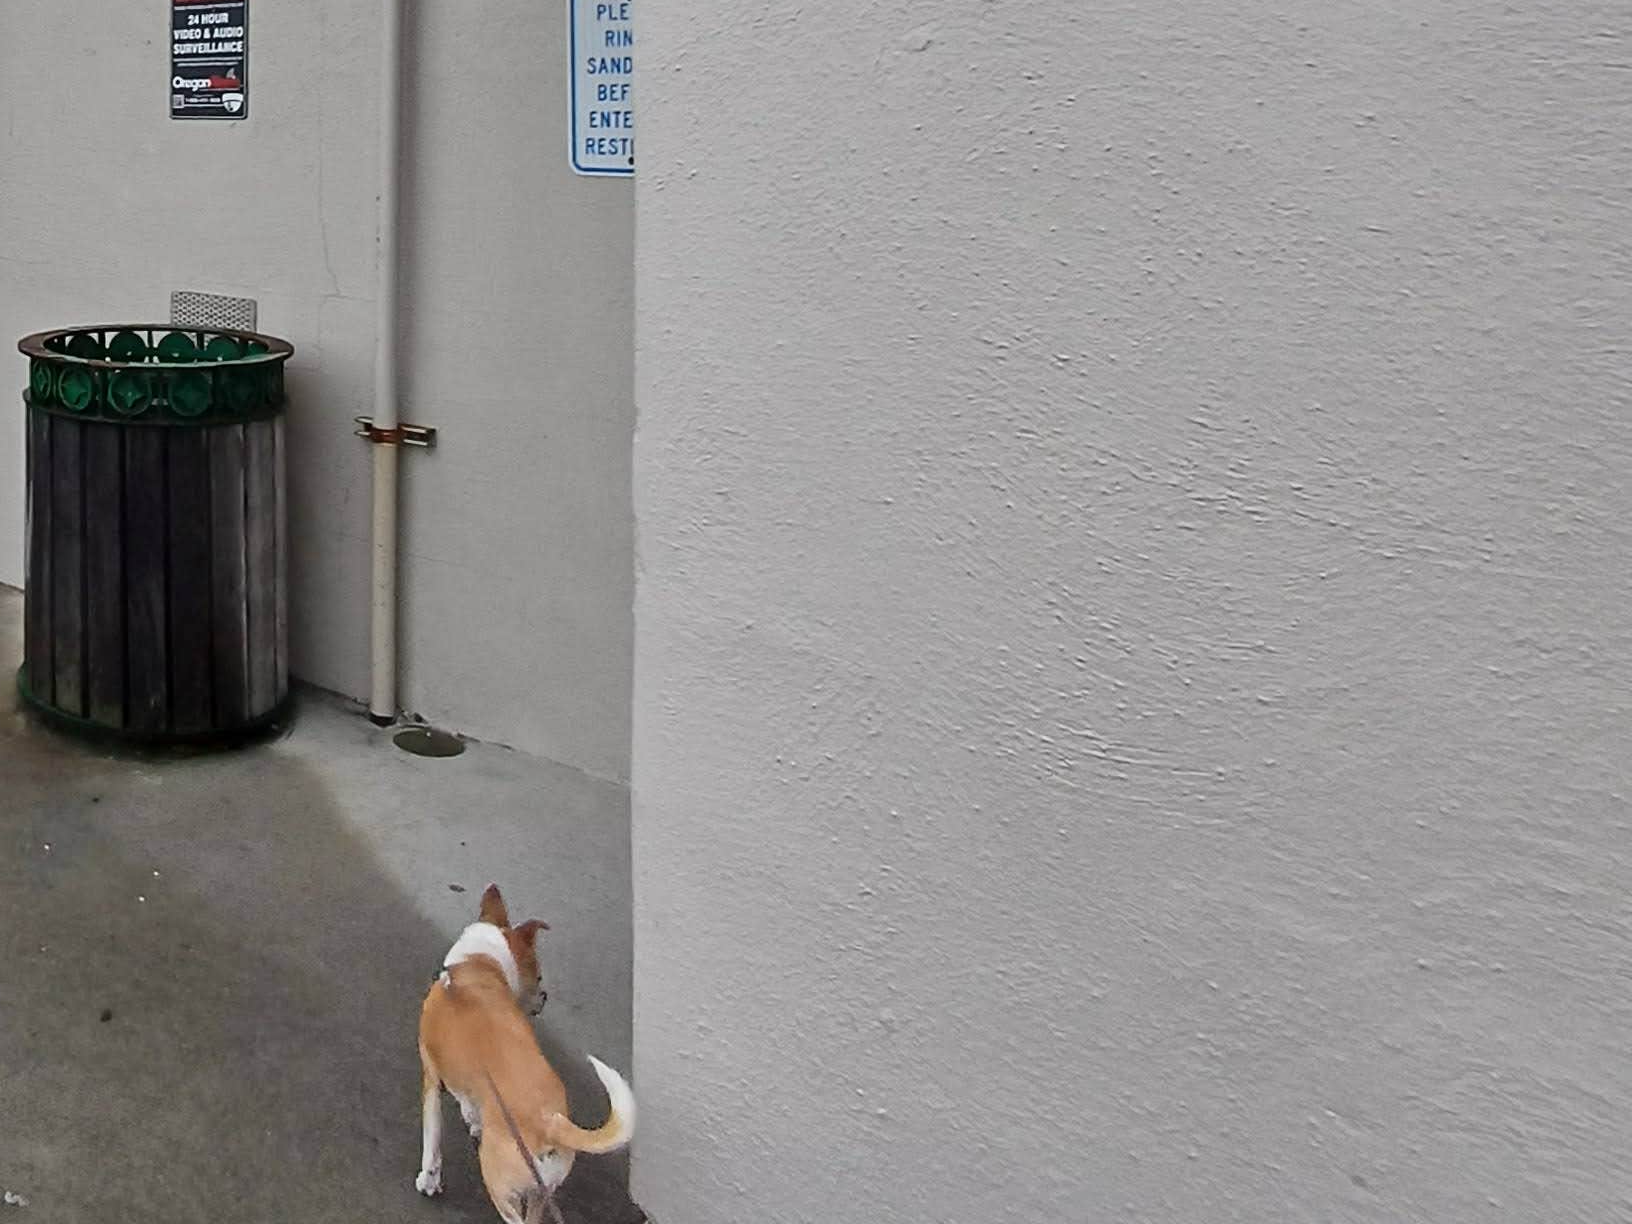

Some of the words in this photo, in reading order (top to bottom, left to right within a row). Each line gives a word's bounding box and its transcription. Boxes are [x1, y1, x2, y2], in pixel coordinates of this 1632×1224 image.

[188, 14, 199, 25] 24
[201, 13, 228, 24] HOUR
[596, 3, 629, 21] PLE
[174, 28, 201, 40] VIDEO
[203, 28, 210, 39] &
[213, 26, 243, 39] AUDIO
[173, 41, 243, 55] SURVEILLANCE
[587, 57, 632, 74] SAND
[173, 76, 211, 92] Oregon
[598, 84, 630, 101] BEF
[589, 111, 633, 128] ENTE
[585, 138, 634, 155] REST
